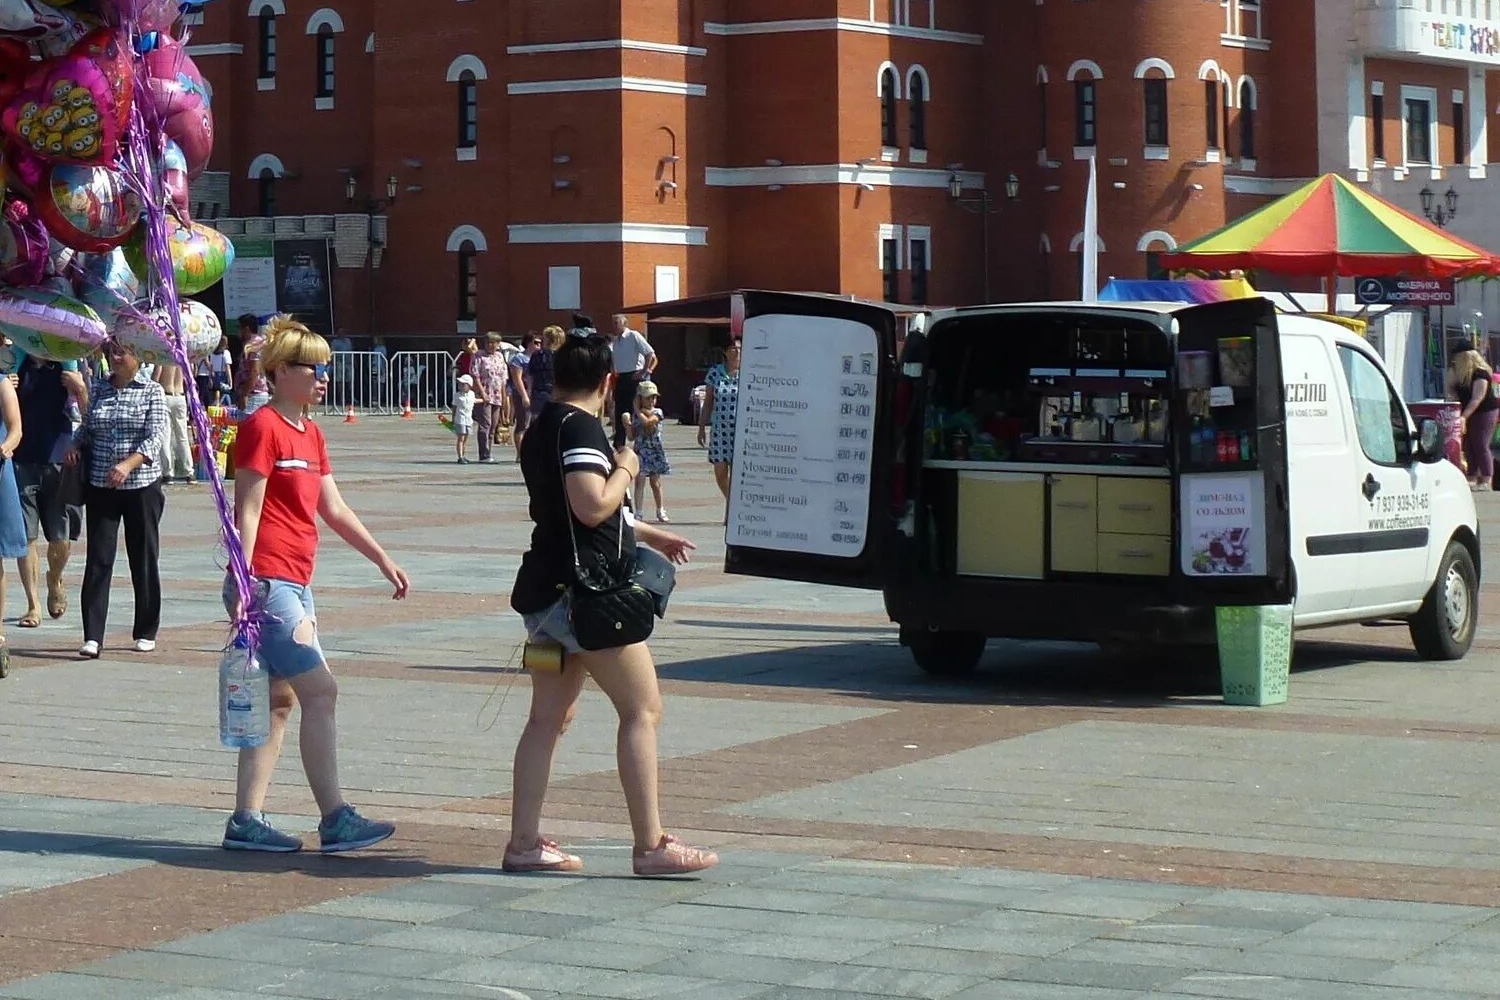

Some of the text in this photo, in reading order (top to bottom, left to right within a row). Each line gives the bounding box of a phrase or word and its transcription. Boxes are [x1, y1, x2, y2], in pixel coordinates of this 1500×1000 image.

[1397, 281, 1440, 290] ФАБРИКА
[1386, 292, 1451, 301] МОРОЖЕНОГО
[748, 373, 799, 388] Эспрессо
[748, 396, 808, 411] Американо
[745, 417, 776, 430] Латте
[743, 439, 798, 455] Капучино
[742, 461, 798, 475] Мокачино
[740, 489, 785, 505] Горячий
[788, 495, 807, 506] чай
